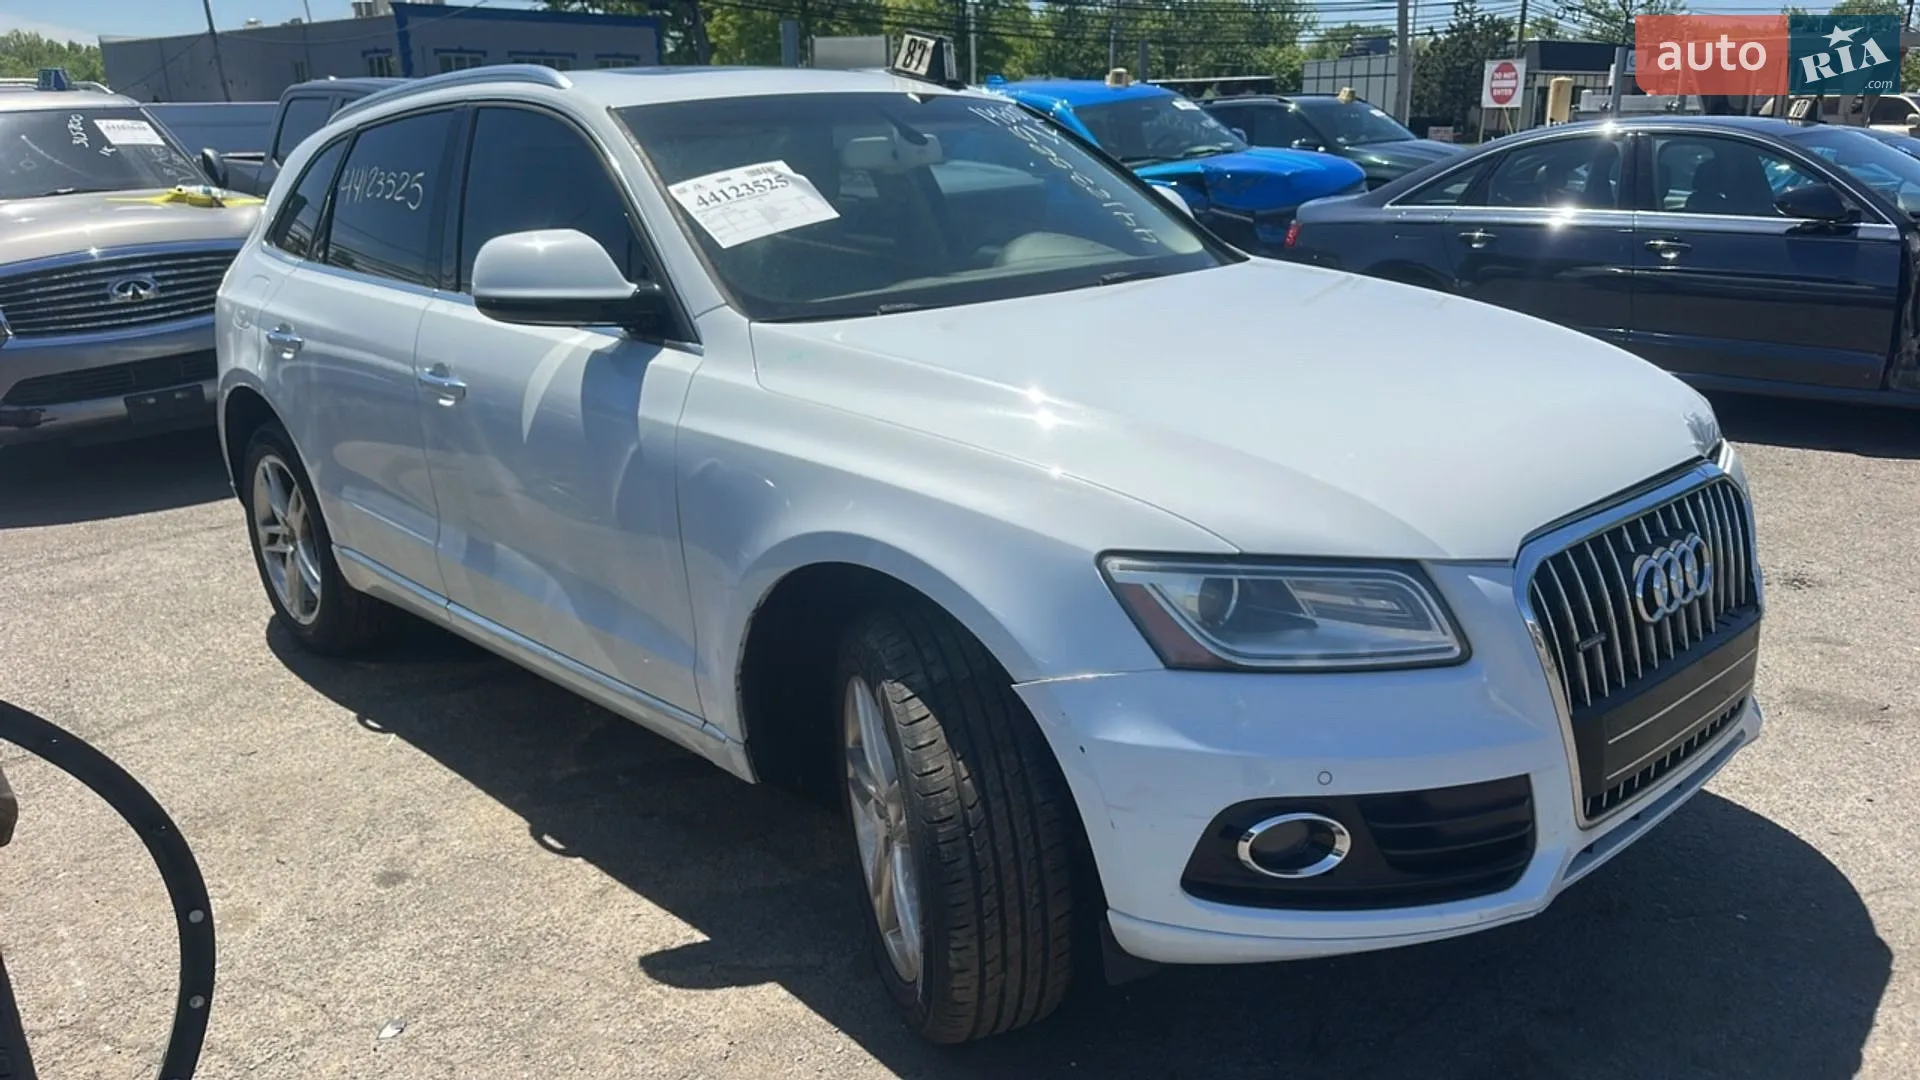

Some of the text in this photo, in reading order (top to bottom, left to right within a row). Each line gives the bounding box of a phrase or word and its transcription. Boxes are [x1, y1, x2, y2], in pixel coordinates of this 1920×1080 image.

[902, 37, 928, 71] 87
[1504, 71, 1516, 80] NOT
[341, 165, 425, 210] 44123525
[696, 174, 789, 208] 44123525
